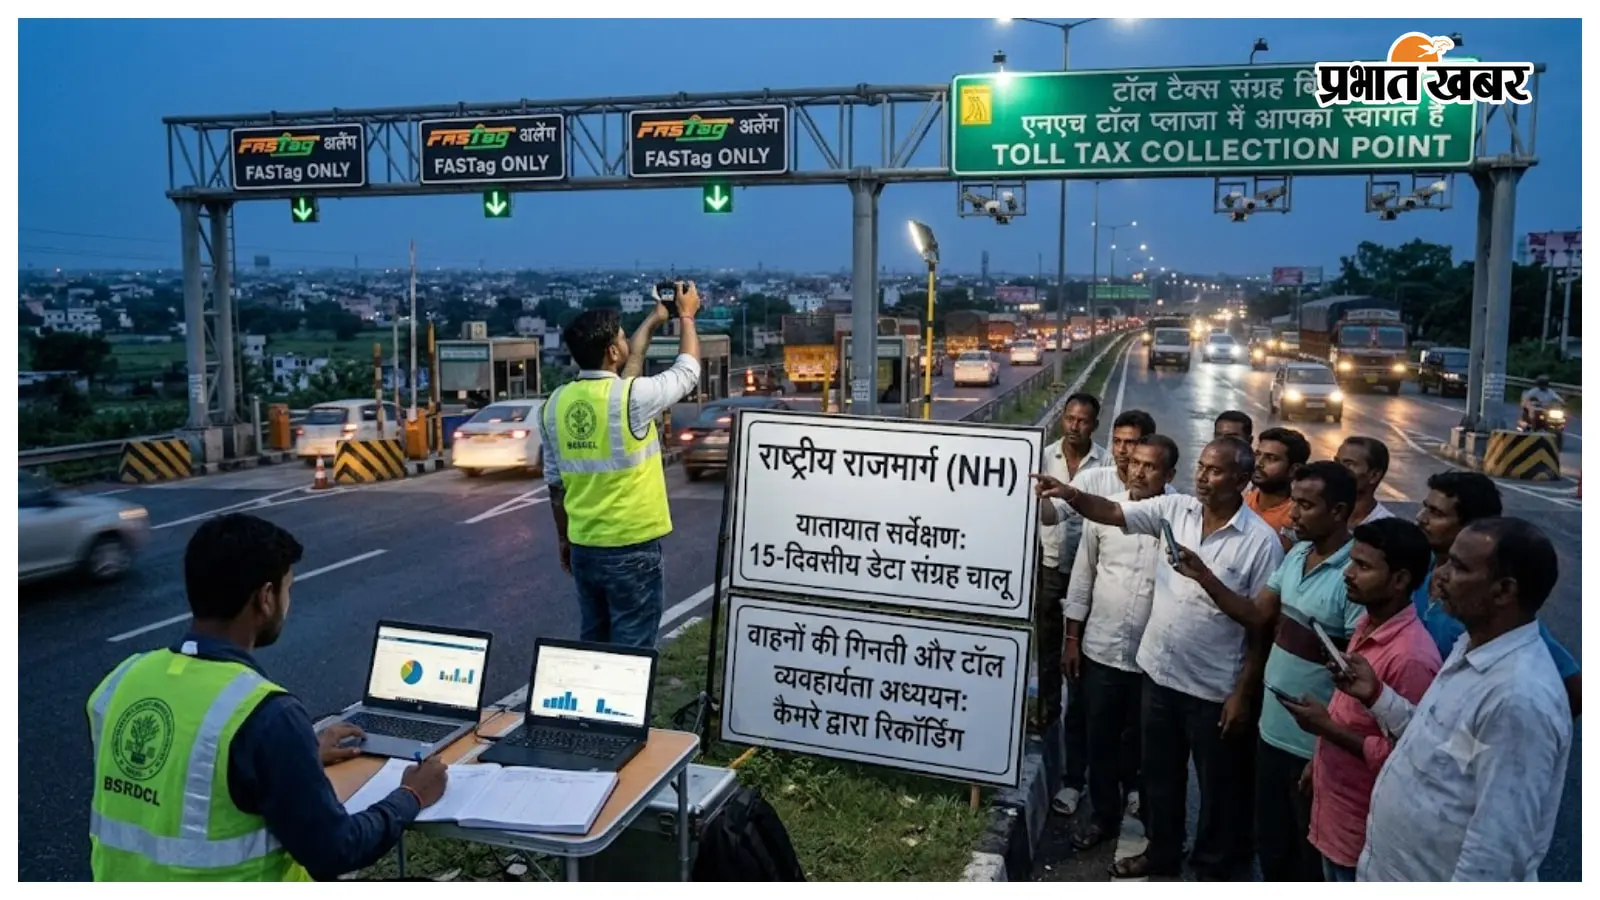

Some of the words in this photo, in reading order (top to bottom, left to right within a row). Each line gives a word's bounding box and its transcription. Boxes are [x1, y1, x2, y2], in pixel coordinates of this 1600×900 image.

[1112, 76, 1157, 102] टॉल
[1167, 73, 1220, 101] टैक्स
[1229, 73, 1284, 99] संग्रह
[1021, 114, 1087, 138] एनएच
[1096, 107, 1141, 133] टॉल
[1149, 111, 1218, 133] प्लाजा
[1227, 103, 1245, 130] में
[1255, 108, 1332, 130] आपका
[1343, 106, 1418, 129] स्वागत
[435, 157, 496, 175] FASTag
[502, 154, 549, 172] ONLY
[645, 150, 712, 168] FASTag
[718, 147, 770, 165] ONLY
[992, 143, 1066, 166] TOLL
[1075, 141, 1132, 164] TAX
[1141, 137, 1339, 162] COLLECTION
[1352, 134, 1451, 159] POINT
[246, 165, 302, 182] FASTag
[307, 162, 350, 179] ONLY
[758, 436, 836, 480] राष्ट्रीय
[843, 446, 938, 483] राजमार्ग
[947, 453, 1018, 496] (NH)
[796, 513, 881, 543] यातायात
[886, 516, 966, 550] सर्वेक्षण:
[750, 541, 861, 577] 15-दिवसीय
[867, 549, 905, 581] डेटा
[911, 555, 961, 587] संग्रह
[966, 565, 1015, 601] चालू
[748, 622, 806, 652] वाहनों
[811, 625, 839, 656] की
[845, 629, 907, 665] गिनती
[914, 638, 956, 672] और
[961, 645, 1005, 678] टॉल
[774, 665, 874, 699] व्यवहार्यता
[880, 679, 968, 712] अध्ययन:
[773, 695, 822, 730] कैमरे
[826, 710, 869, 738] द्वारा
[875, 710, 964, 751] रिकॉर्डिंग
[104, 776, 161, 806] BSRDCL
